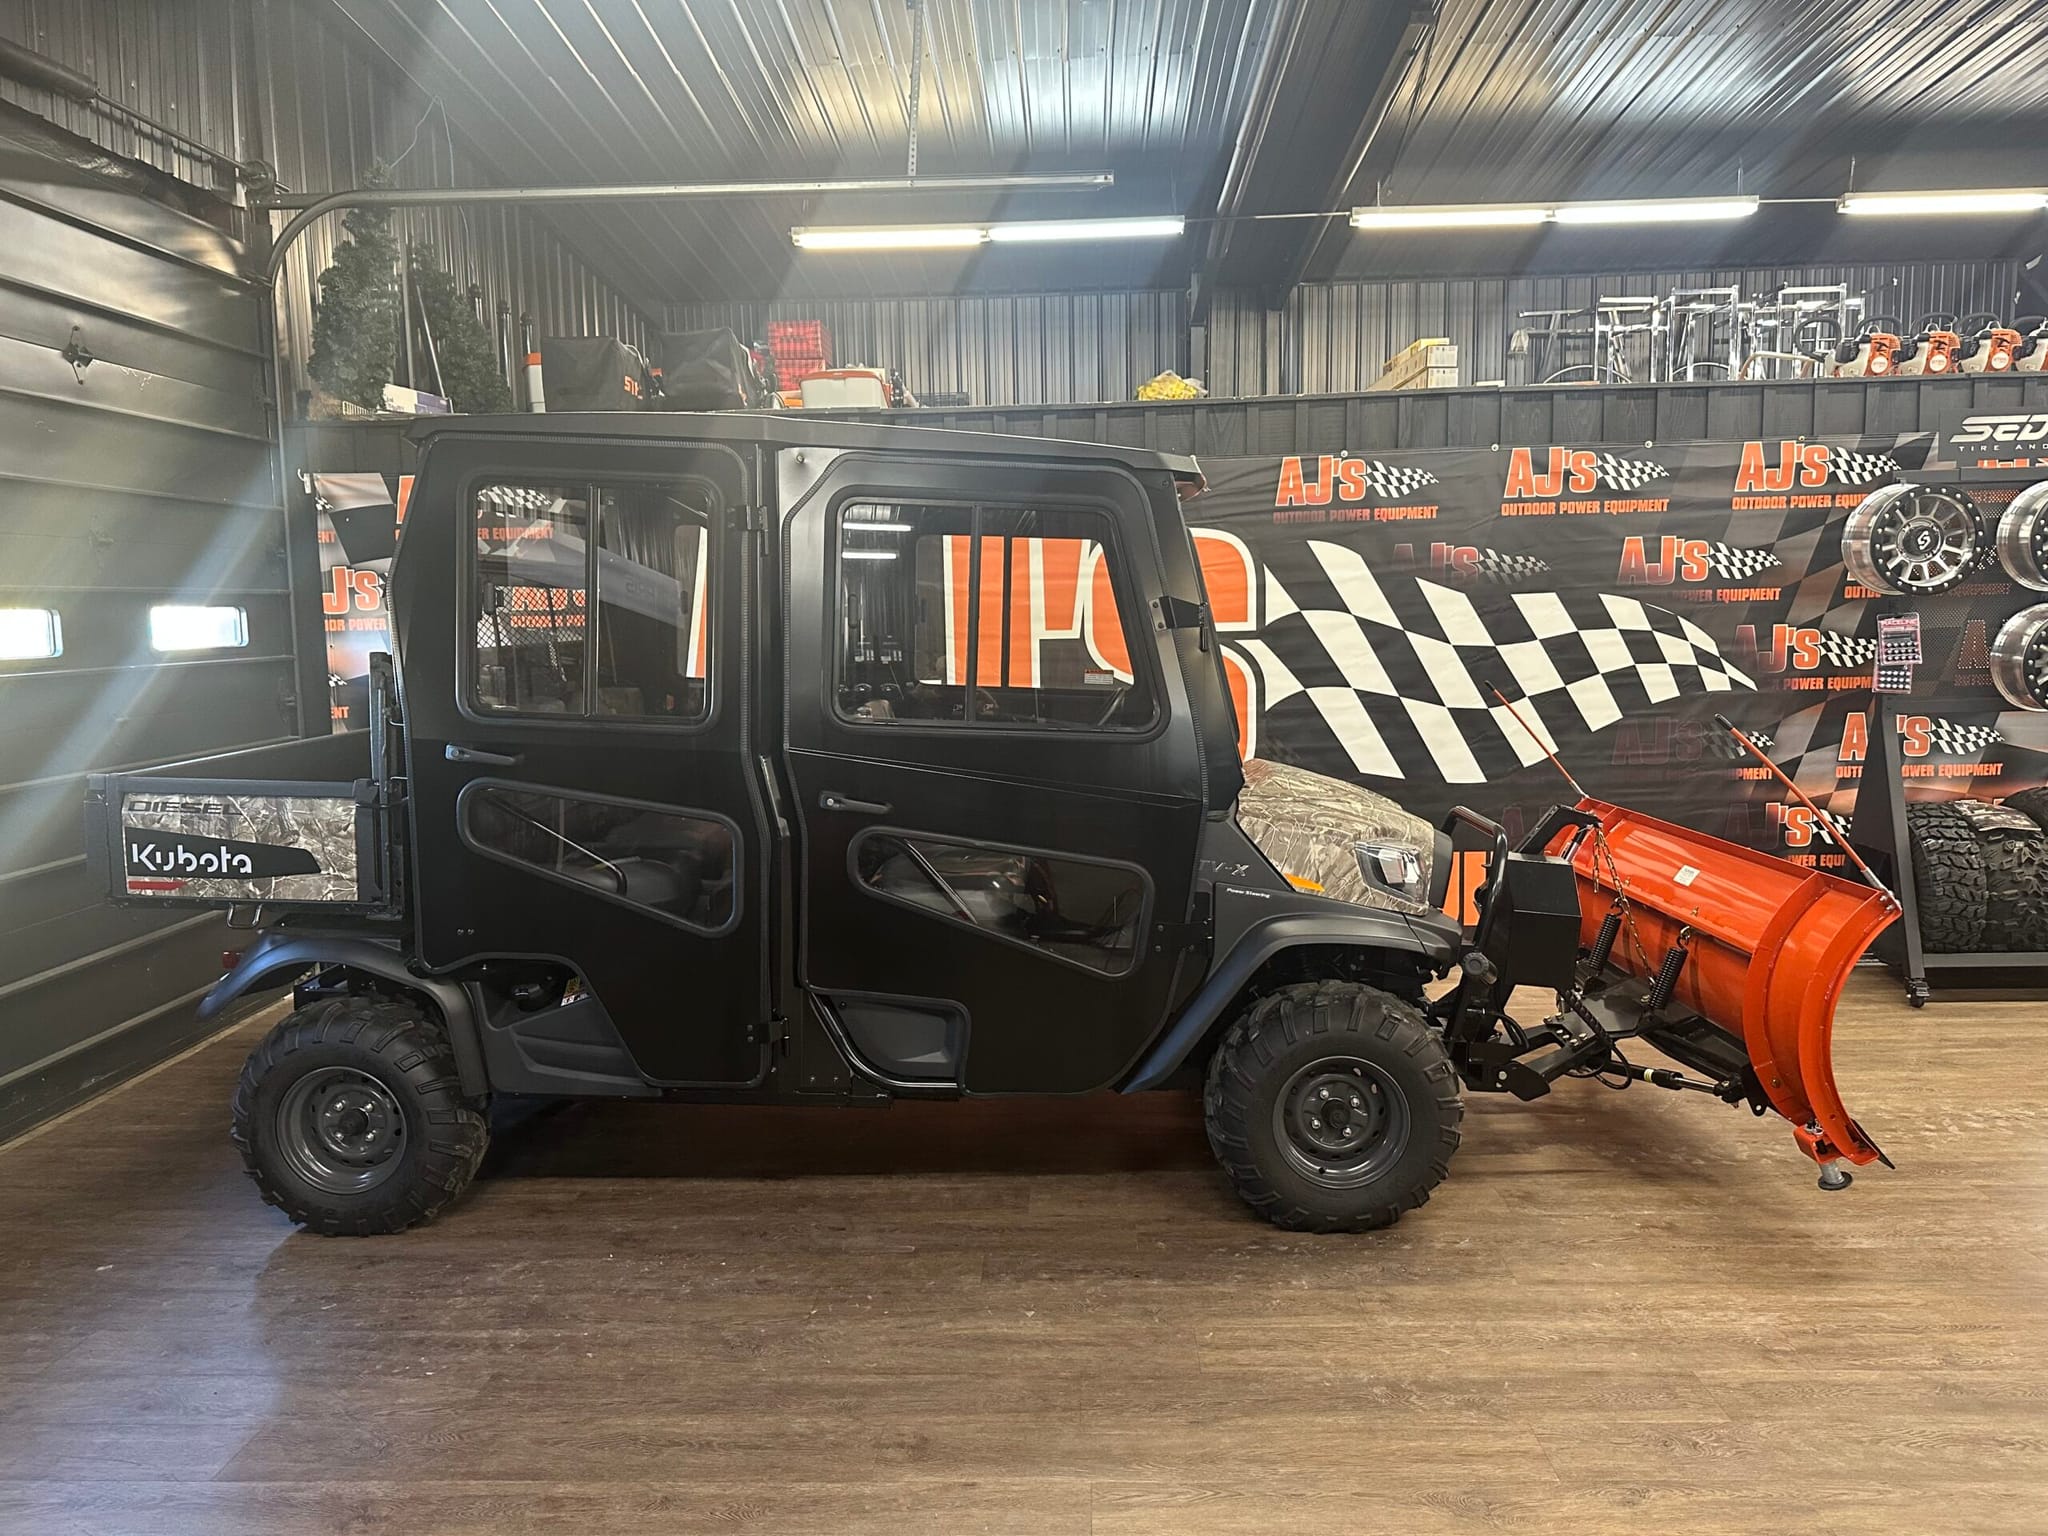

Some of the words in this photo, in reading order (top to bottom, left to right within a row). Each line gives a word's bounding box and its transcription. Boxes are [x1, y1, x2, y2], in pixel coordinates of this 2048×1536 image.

[1959, 444, 2001, 452] TIRE
[1501, 501, 1556, 517] OUTDOOR
[1559, 499, 1601, 514] POWER
[1603, 498, 1670, 516] EQUIPMENT
[1731, 495, 1787, 511] OUTDOOR
[1789, 494, 1832, 509] POWER
[1273, 509, 1326, 525] OUTDOOR
[1329, 508, 1370, 522] POWER
[1373, 505, 1439, 522] EQUIPMENT
[1716, 587, 1782, 604] EQUIPMENT
[349, 617, 387, 631] POWER
[1783, 676, 1824, 691] POWER
[1938, 762, 2003, 779] EQUIPMENT
[127, 800, 243, 816] DIESEL
[131, 843, 253, 874] Kubota
